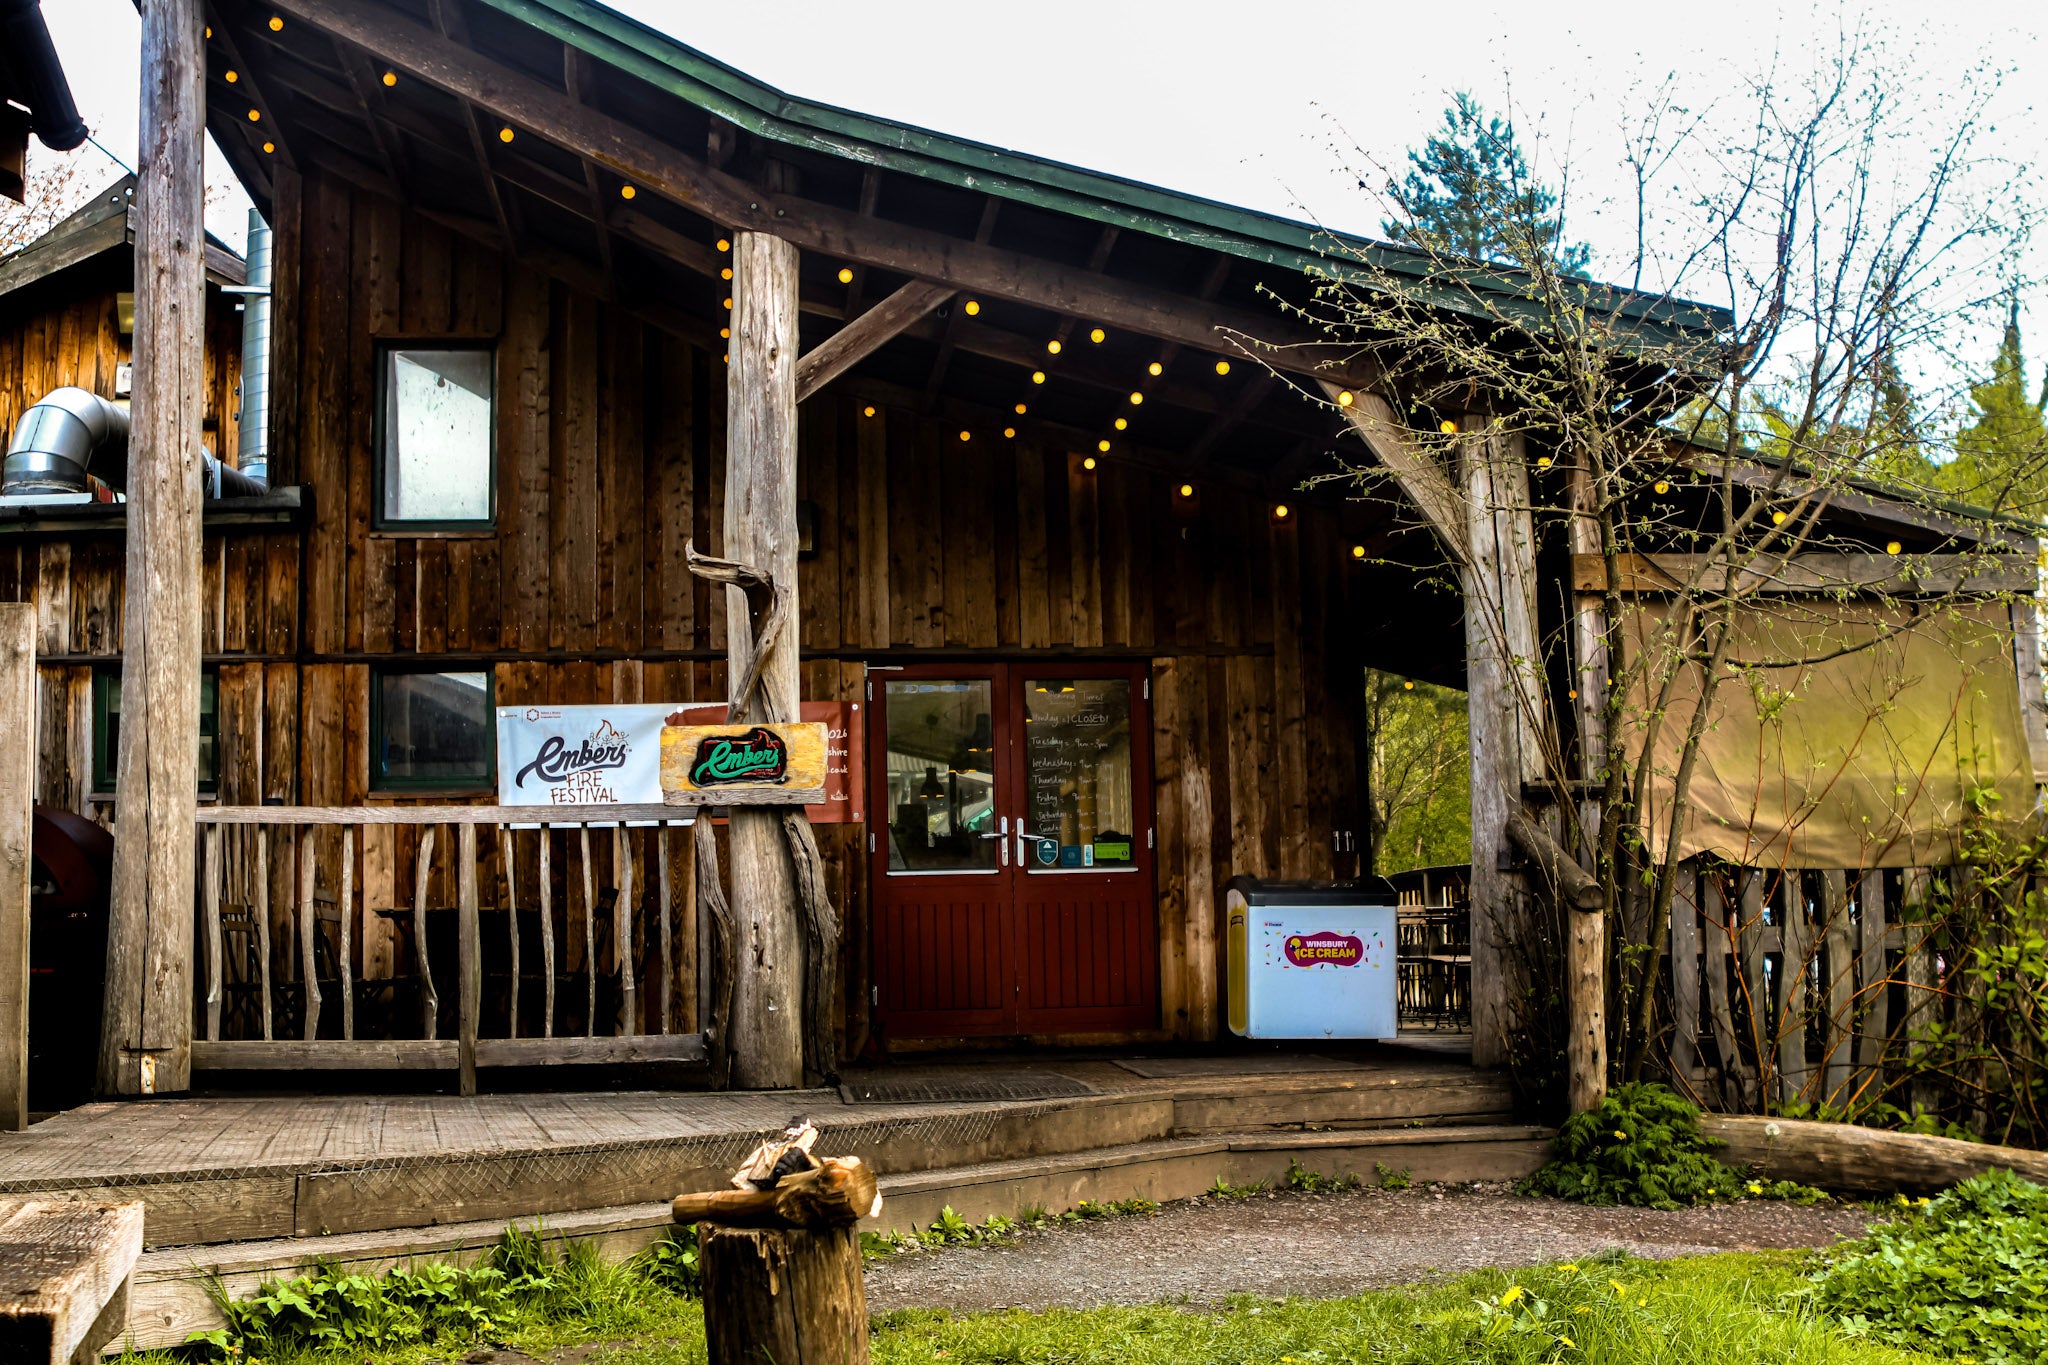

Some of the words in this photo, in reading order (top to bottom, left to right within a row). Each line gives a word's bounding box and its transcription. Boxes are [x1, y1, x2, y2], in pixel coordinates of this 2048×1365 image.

[515, 736, 626, 788] Embers
[694, 741, 779, 782] Embers
[550, 787, 618, 804] FESTIVAL
[1316, 948, 1356, 958] CREAM
